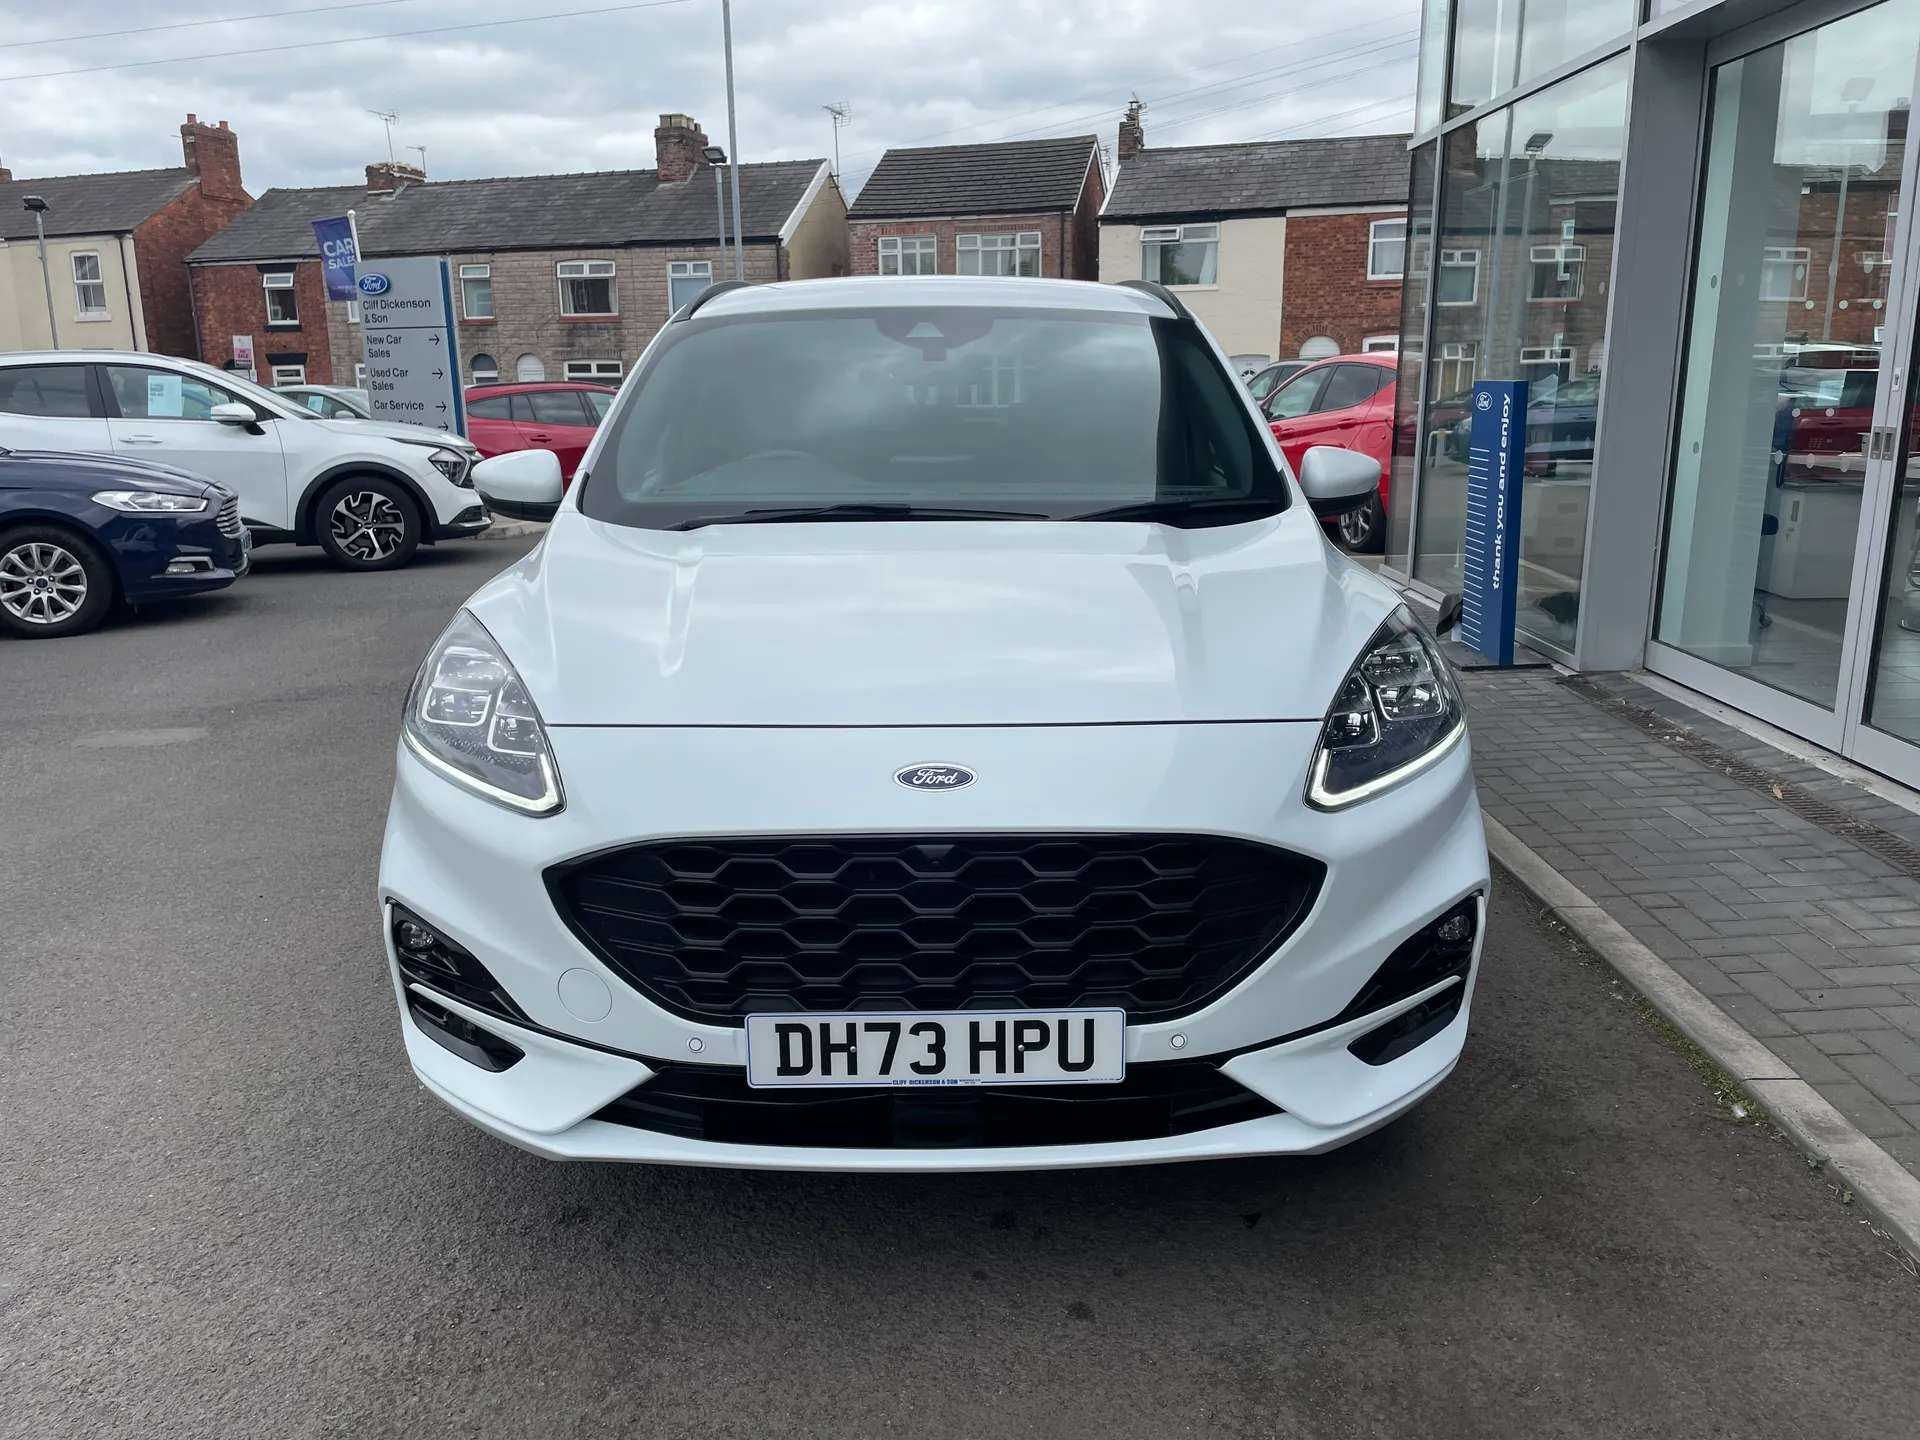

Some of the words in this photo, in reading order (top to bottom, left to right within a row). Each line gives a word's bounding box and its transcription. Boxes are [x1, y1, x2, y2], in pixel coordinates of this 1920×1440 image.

[323, 238, 354, 257] CAR
[362, 300, 379, 310] Cliff
[381, 299, 431, 310] Dickenson
[365, 315, 371, 323] &
[371, 314, 388, 323] Son
[366, 335, 385, 345] New
[386, 334, 402, 345] Car
[368, 348, 391, 358] Sales
[370, 368, 391, 378] Used
[392, 367, 408, 378] Car
[371, 381, 394, 391] Sales
[373, 400, 388, 410] Car
[389, 399, 425, 410] Service
[1501, 393, 1511, 448] enjoy
[1497, 452, 1506, 489] and
[1496, 496, 1505, 530] you
[1492, 534, 1502, 590] thank
[912, 768, 958, 785] Ford
[775, 1021, 946, 1077] DH73
[969, 1018, 1095, 1075] HPU
